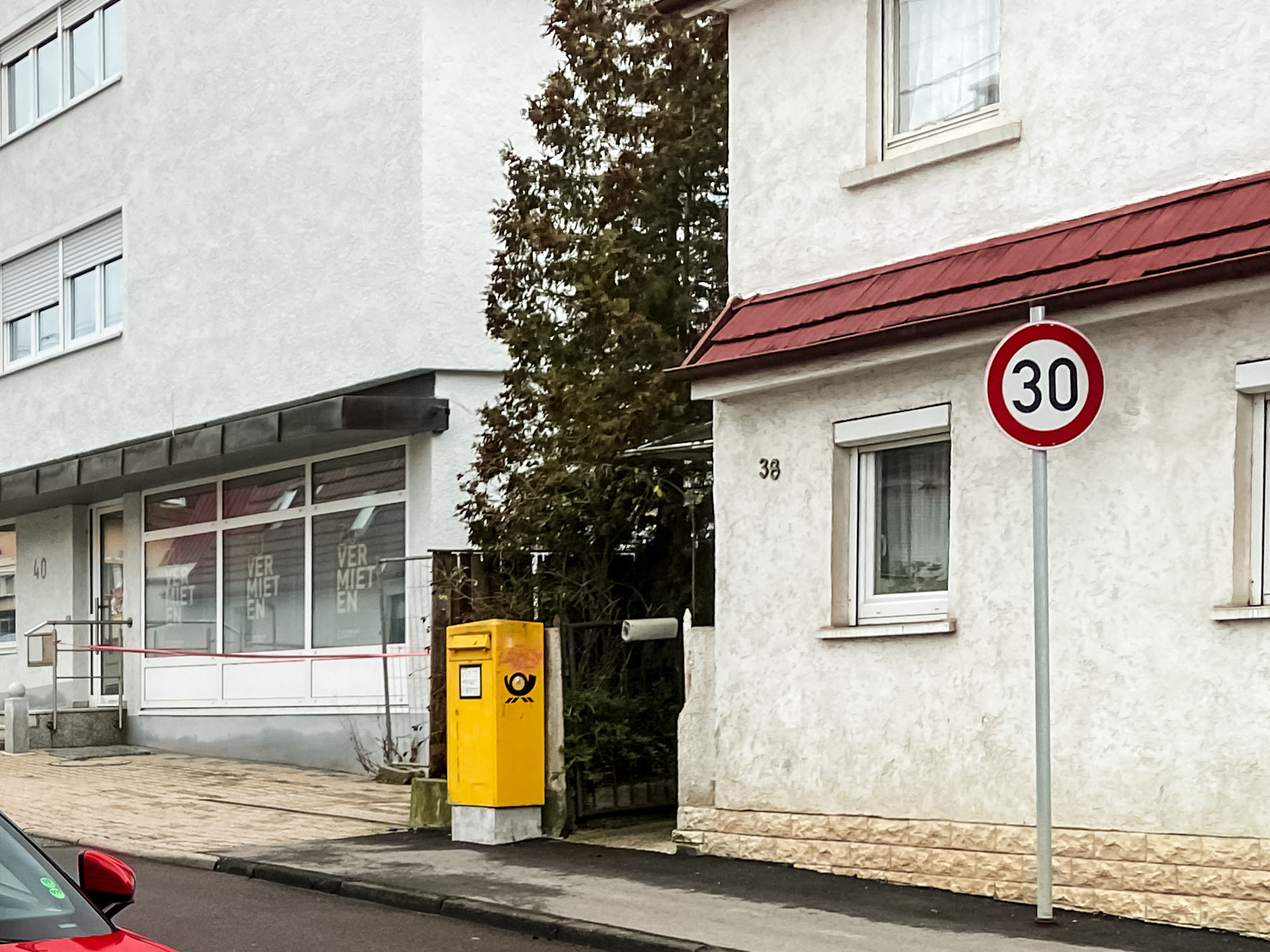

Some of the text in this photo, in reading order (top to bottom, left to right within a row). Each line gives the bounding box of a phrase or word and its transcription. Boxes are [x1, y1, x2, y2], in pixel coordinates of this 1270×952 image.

[1012, 357, 1078, 413] 30
[759, 458, 781, 480] 38
[247, 554, 274, 578] VER
[337, 543, 368, 567] VER
[33, 557, 47, 580] 40
[336, 565, 376, 591] MIET
[246, 574, 280, 600] MIET
[246, 597, 266, 620] EN
[336, 589, 358, 614] EN
